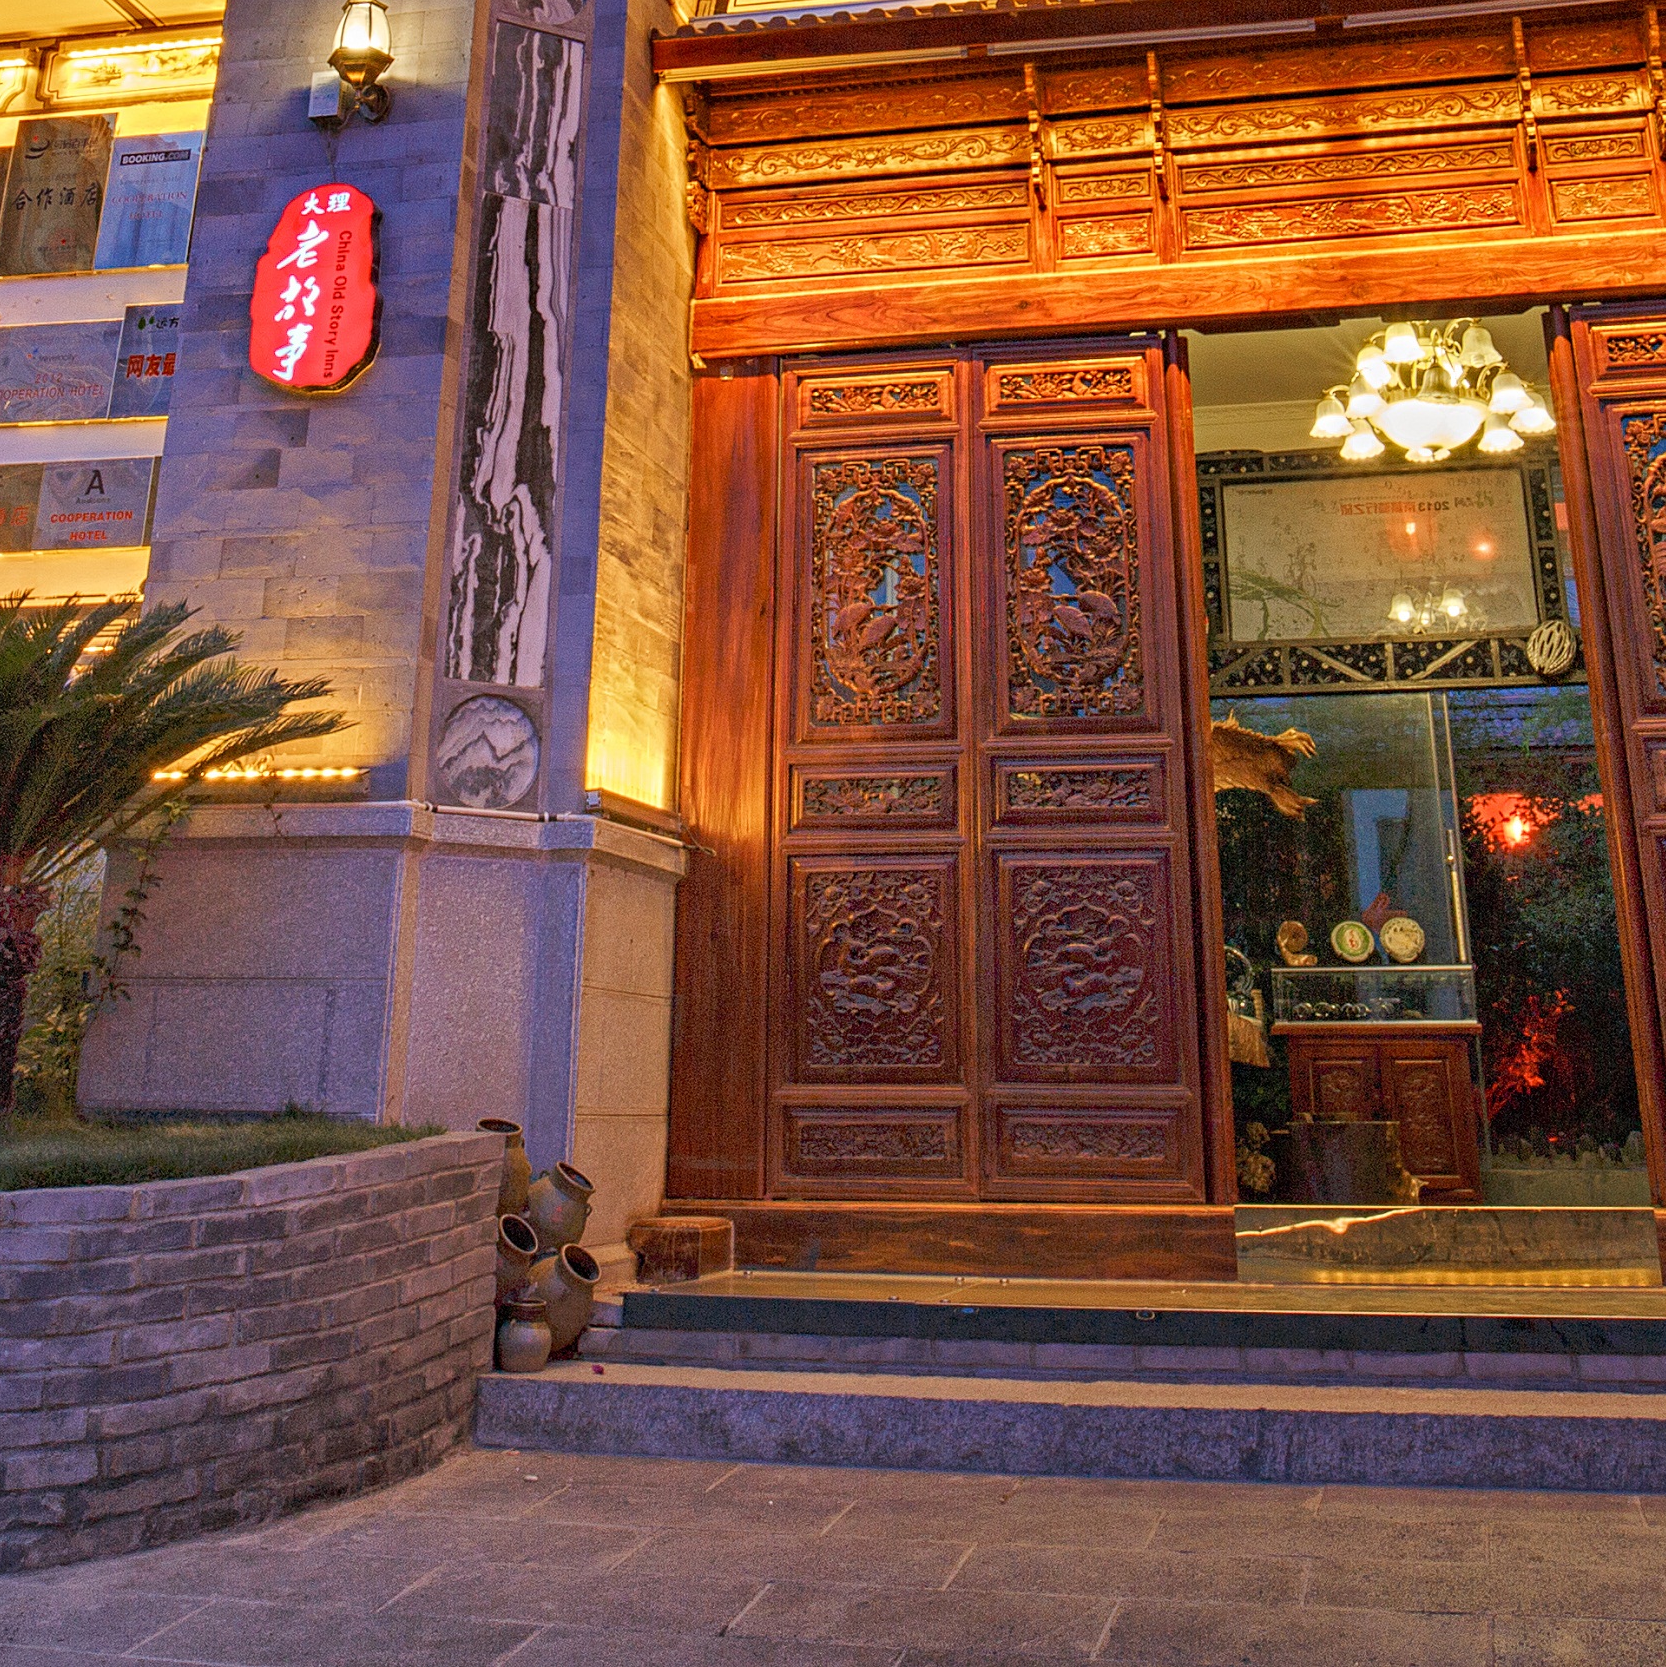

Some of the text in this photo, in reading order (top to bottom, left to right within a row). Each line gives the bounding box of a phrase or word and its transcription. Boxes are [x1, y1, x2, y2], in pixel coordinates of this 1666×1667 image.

[11, 183, 100, 211] 合作酒店
[301, 192, 351, 215] 大理
[273, 220, 329, 381] 老故事
[322, 230, 353, 379] China Old Story Inns
[50, 510, 133, 524] COOPERATION
[69, 530, 108, 541] HOTEL
